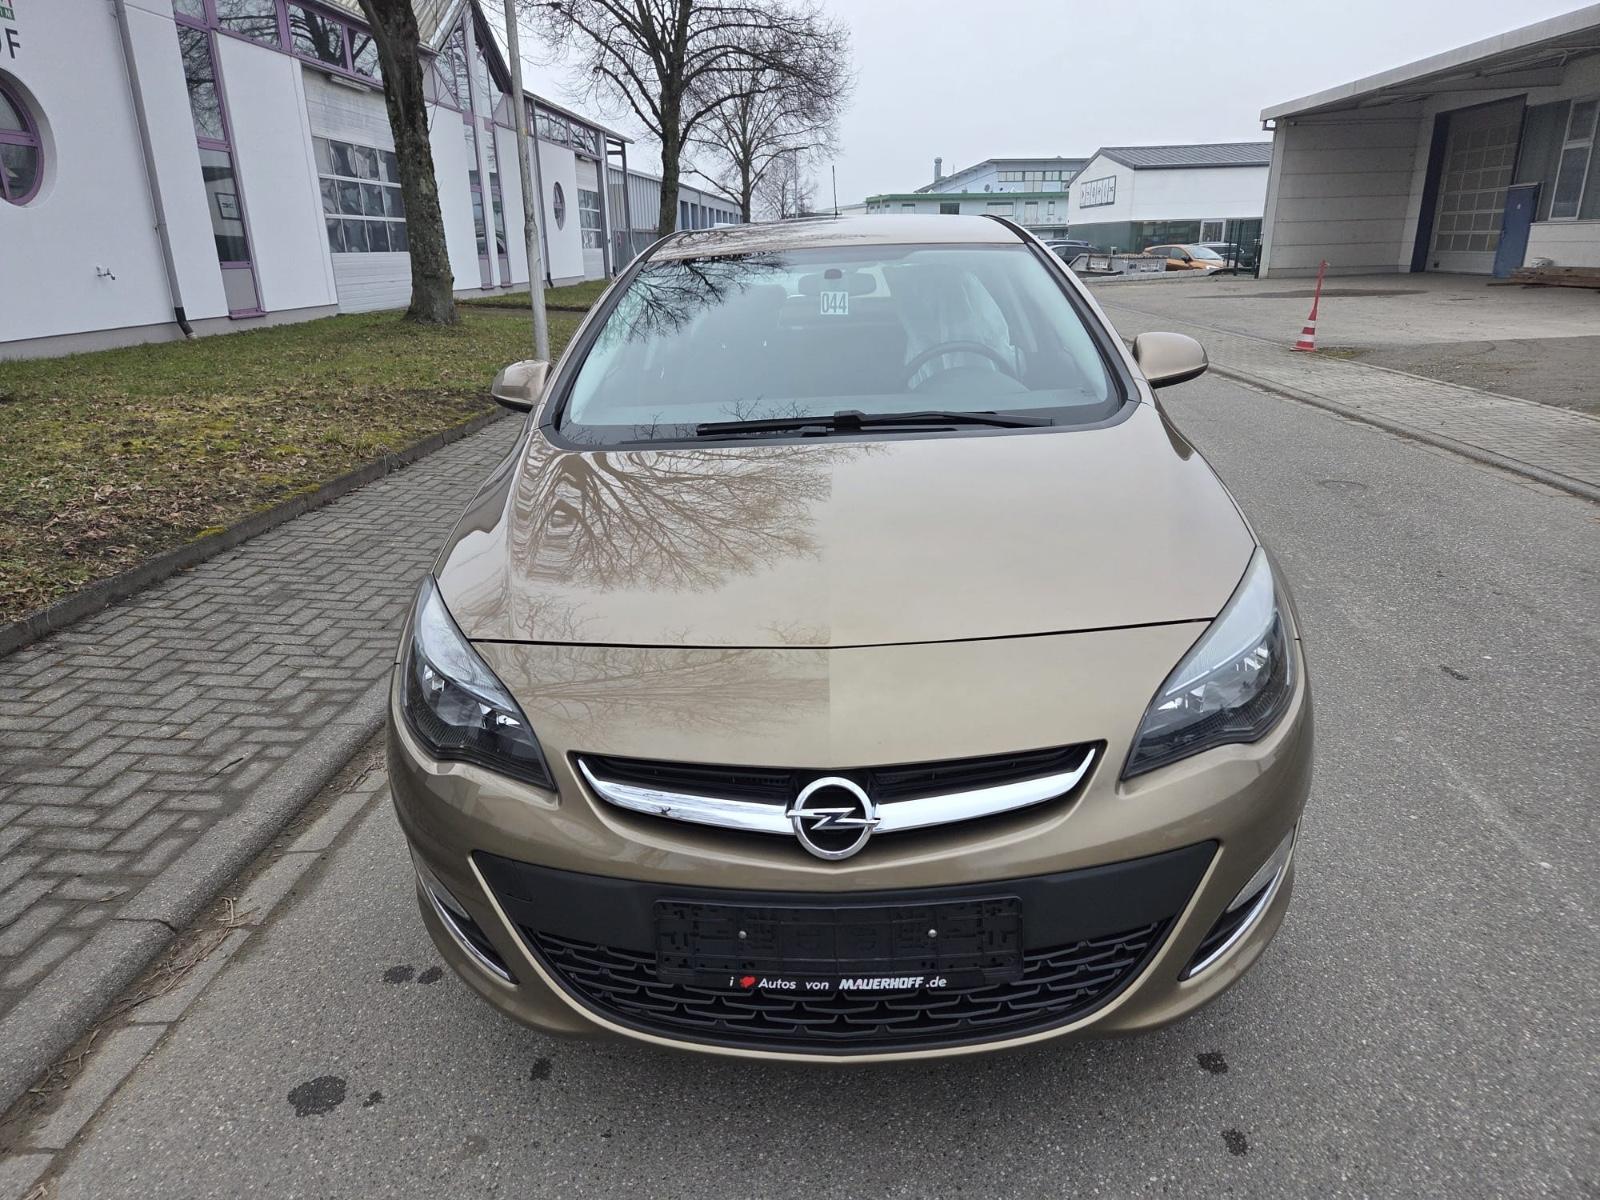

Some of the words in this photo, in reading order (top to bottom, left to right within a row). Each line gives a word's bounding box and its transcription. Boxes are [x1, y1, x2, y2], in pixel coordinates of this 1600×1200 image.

[0, 28, 21, 59] F
[822, 292, 847, 313] 044
[758, 978, 797, 989] Autos
[805, 981, 830, 990] von
